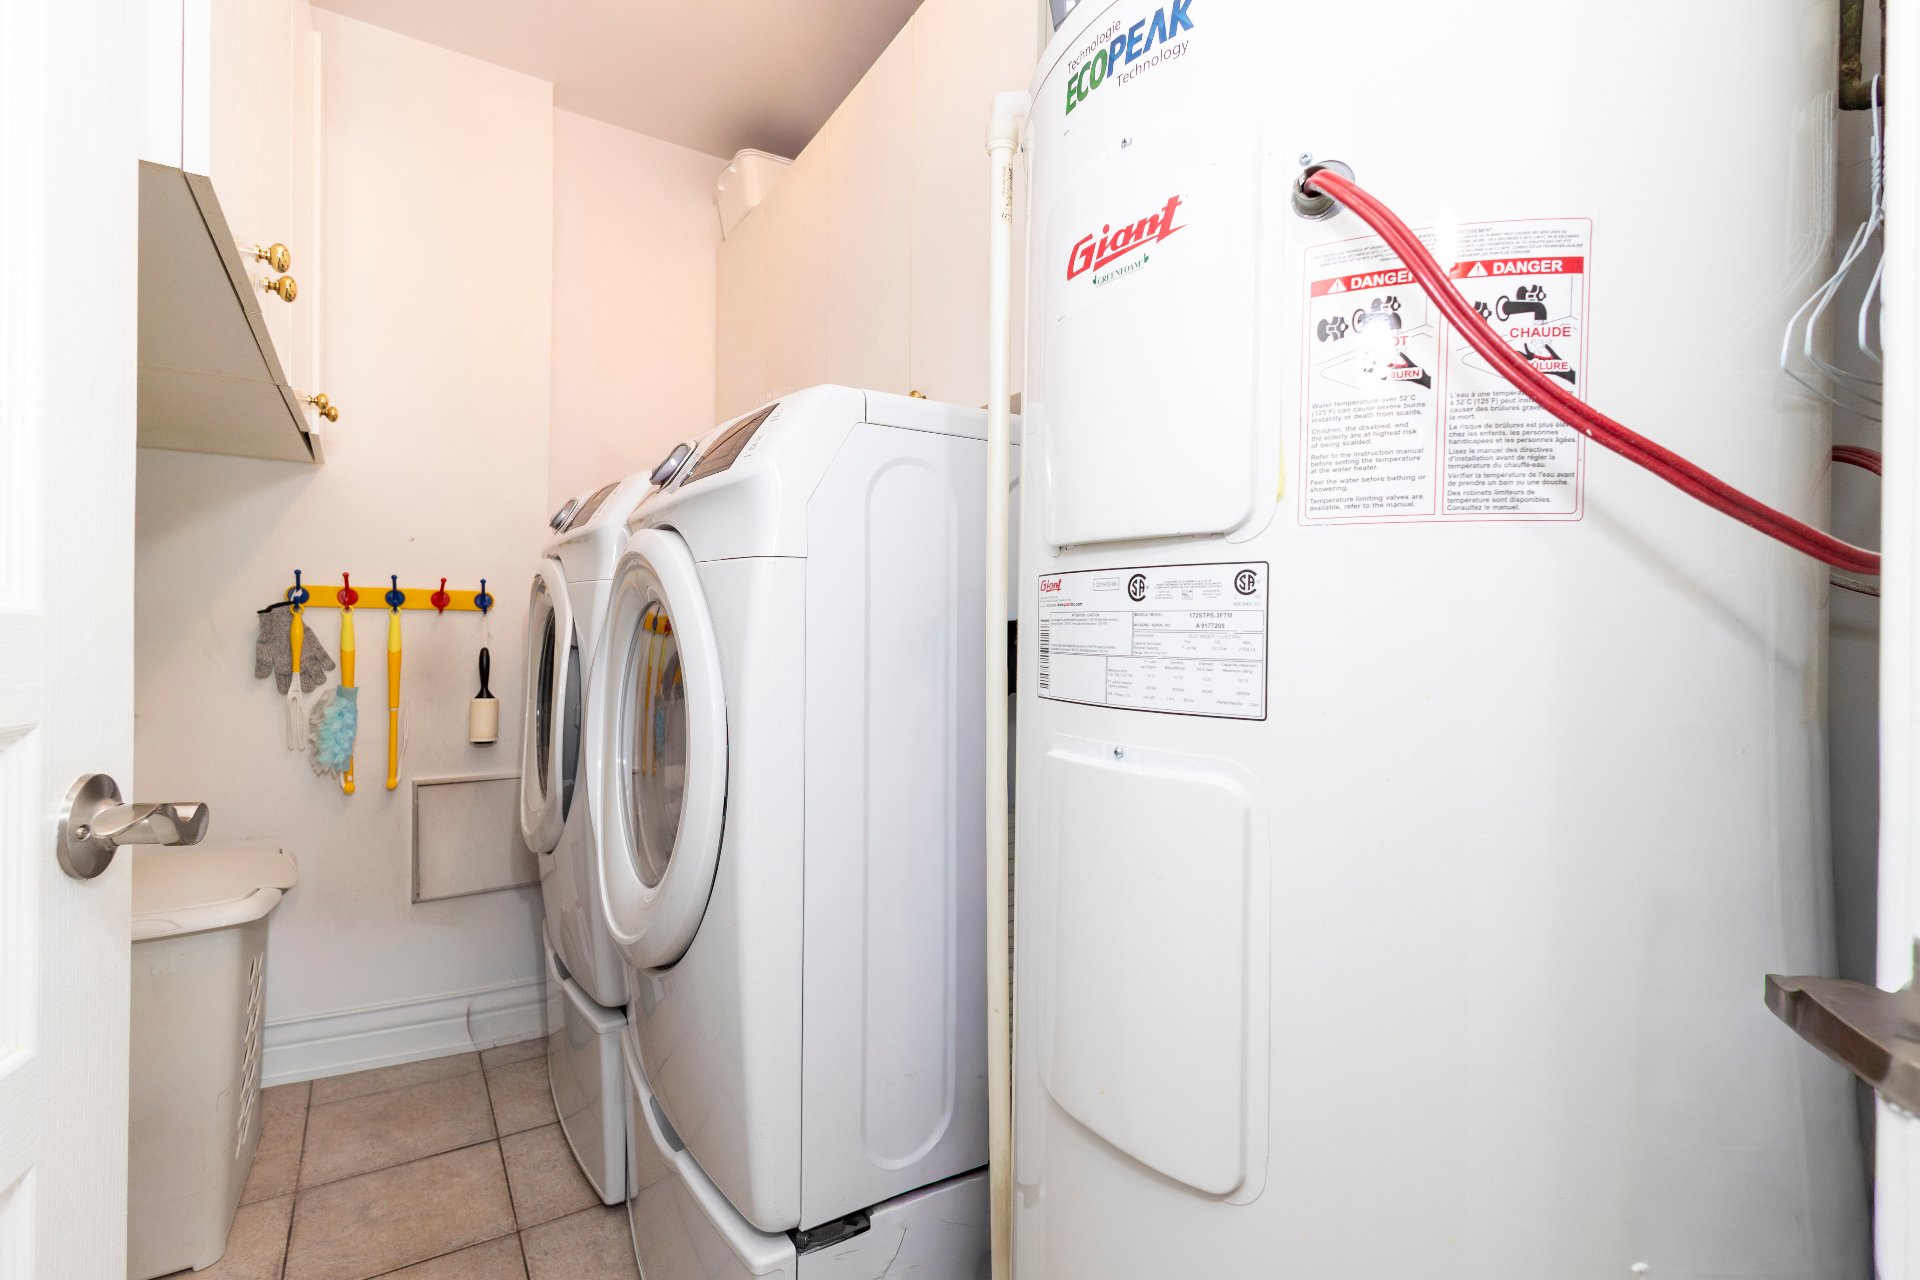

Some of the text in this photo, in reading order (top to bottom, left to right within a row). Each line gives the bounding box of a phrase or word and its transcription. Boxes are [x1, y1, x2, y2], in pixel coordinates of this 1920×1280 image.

[1067, 20, 1121, 74] Technologie
[1066, 0, 1194, 116] ECOPEAK
[1117, 40, 1189, 87] Technology
[1067, 195, 1188, 281] Giant
[1493, 260, 1563, 274] DANGER
[1510, 327, 1571, 338] CHAUDE
[1334, 398, 1378, 407] temperature
[1490, 404, 1520, 412] brûlures
[1311, 415, 1341, 423] instantly
[1495, 421, 1524, 429] brûlures
[1324, 433, 1347, 441] elderly
[1448, 437, 1493, 445] handicapées
[1516, 436, 1553, 444] personnes
[1354, 449, 1393, 457] instruction
[1448, 454, 1493, 462] d'installation
[1527, 453, 1547, 461] régler
[1448, 462, 1490, 470] température
[1483, 471, 1526, 479] température
[1458, 479, 1486, 487] prendre
[1462, 488, 1492, 496] robinets
[1447, 496, 1490, 504] température
[1447, 503, 1482, 511] Consultez
[1040, 579, 1062, 592] Giant
